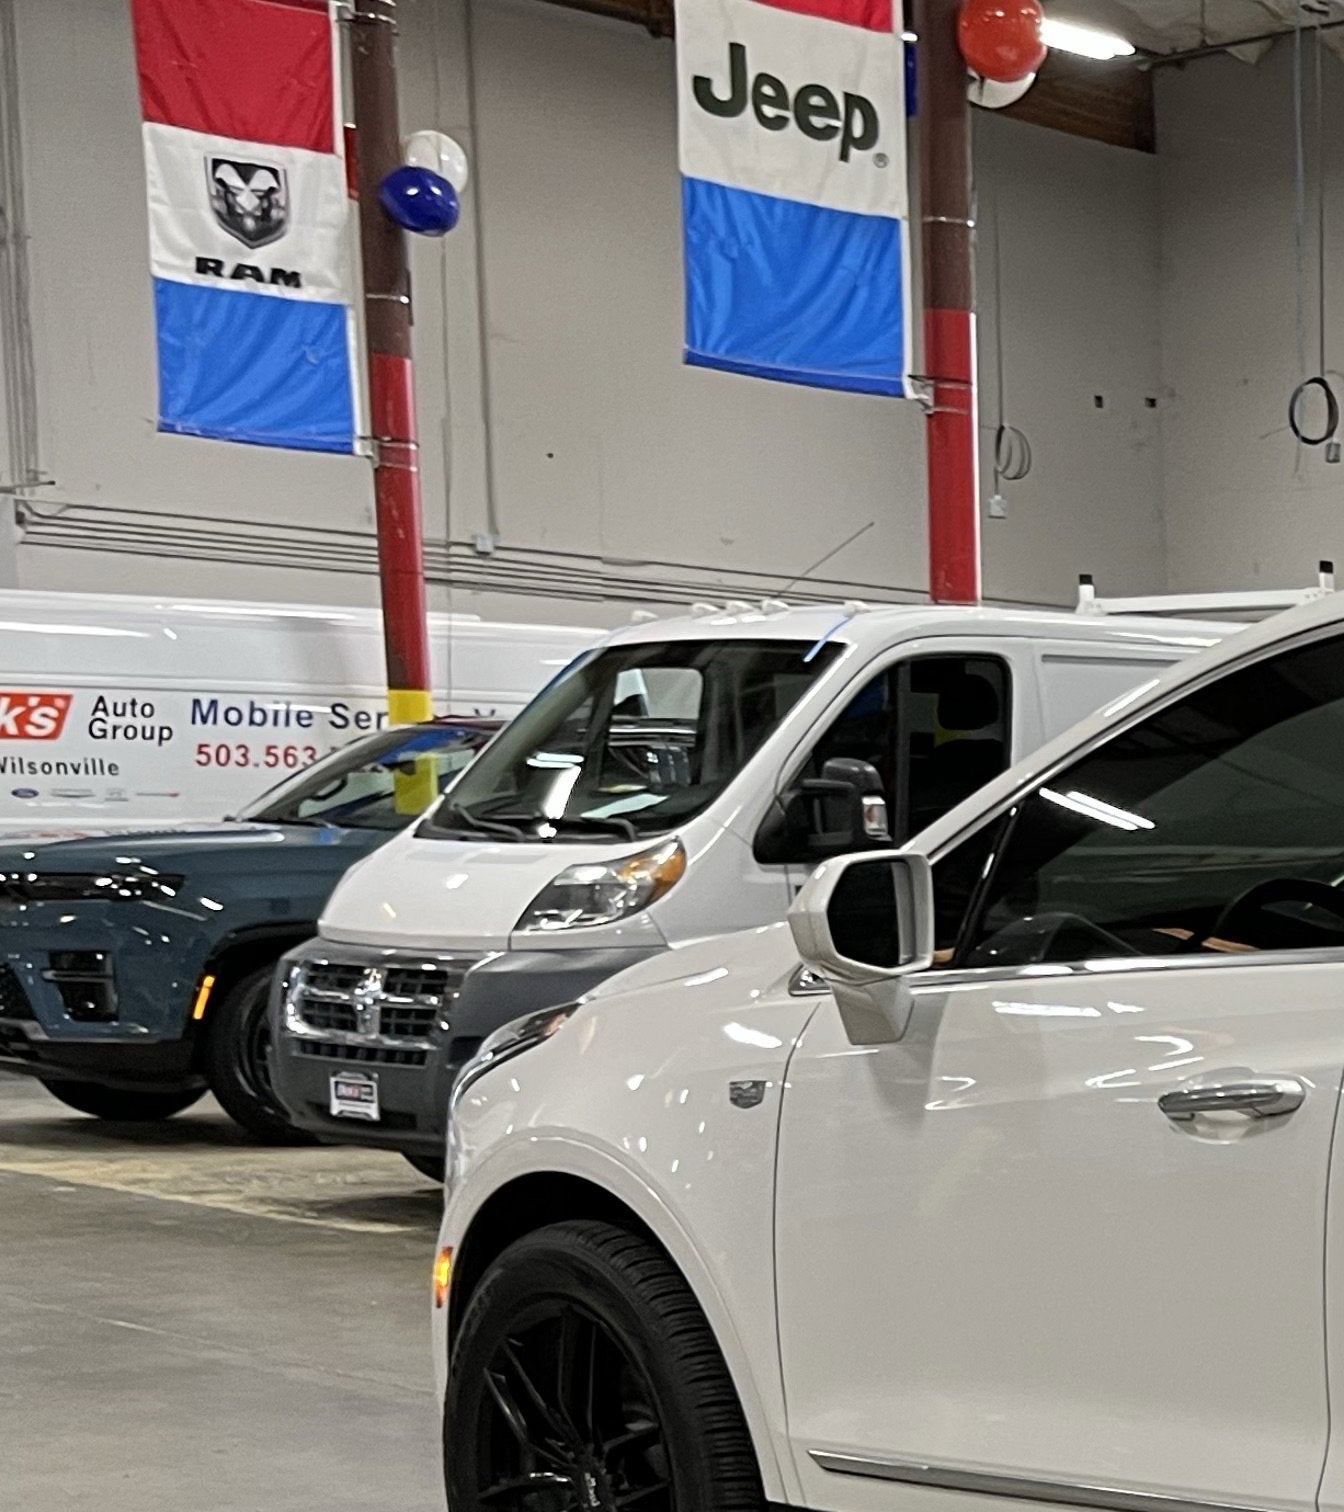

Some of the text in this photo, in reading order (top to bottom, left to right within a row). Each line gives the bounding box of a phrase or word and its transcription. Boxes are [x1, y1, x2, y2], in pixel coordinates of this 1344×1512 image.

[693, 42, 880, 163] Jeep
[195, 256, 302, 289] RAM
[91, 695, 155, 718] Auto
[190, 698, 388, 730] Mobile Ser
[88, 717, 173, 747] Group
[195, 743, 317, 769] 503.563
